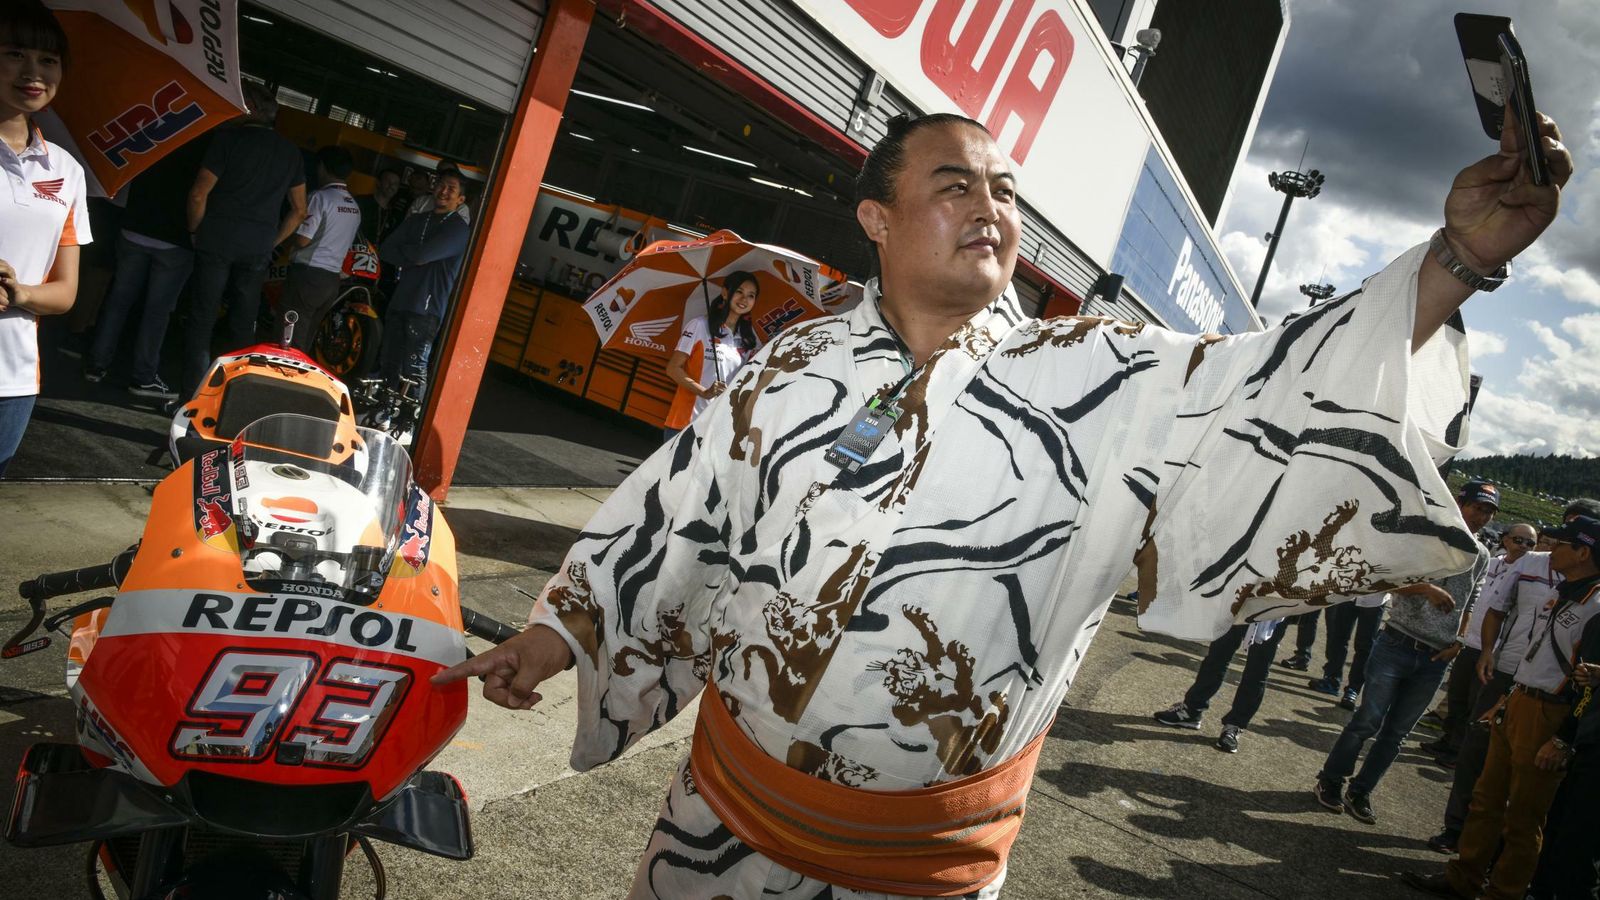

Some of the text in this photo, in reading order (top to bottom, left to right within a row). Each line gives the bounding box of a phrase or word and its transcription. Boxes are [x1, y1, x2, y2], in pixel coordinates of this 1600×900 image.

[87, 80, 207, 170] HRC
[854, 112, 866, 132] 5
[337, 206, 360, 215] HONDA
[352, 252, 379, 274] 26
[802, 267, 815, 300] REPSOL
[1167, 236, 1226, 334] Panasonic
[594, 302, 614, 332] REPSOL
[624, 336, 667, 353] HONDA
[281, 583, 345, 600] HONDA
[182, 593, 417, 652] REPSOL
[168, 646, 415, 772] 93
